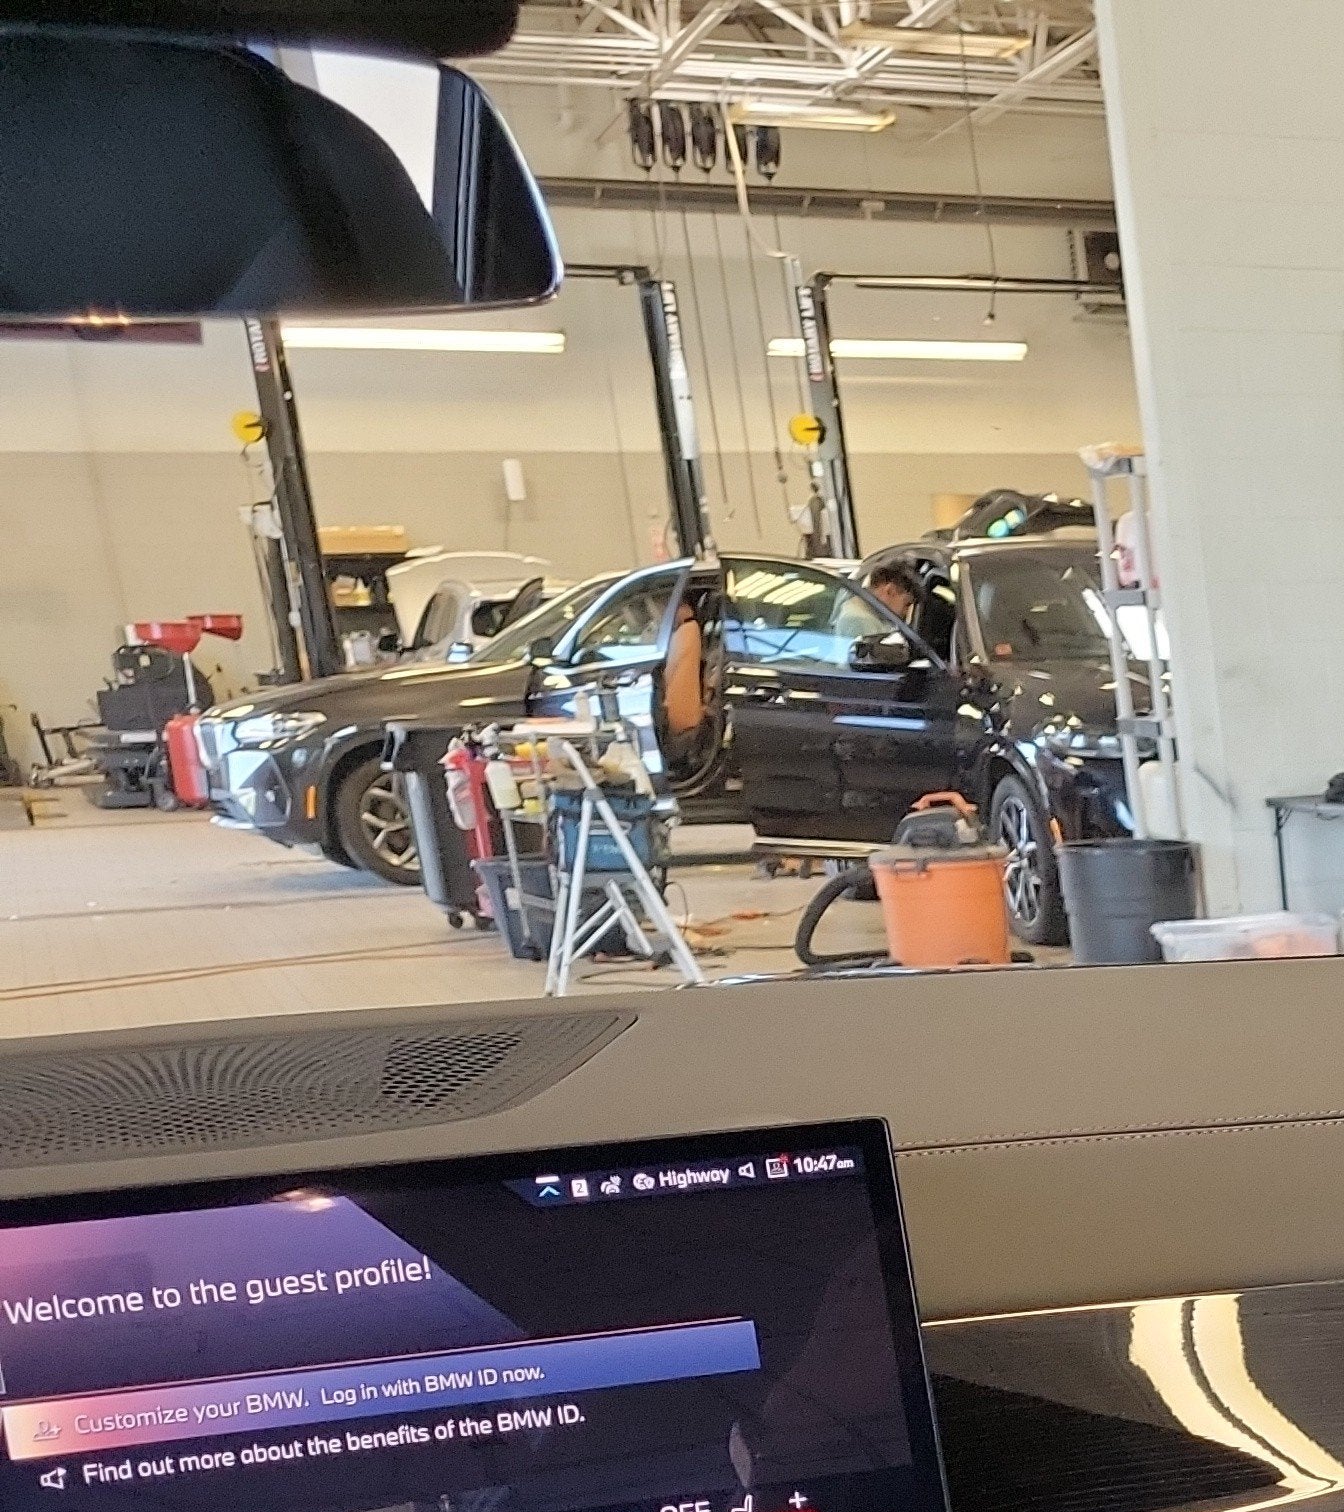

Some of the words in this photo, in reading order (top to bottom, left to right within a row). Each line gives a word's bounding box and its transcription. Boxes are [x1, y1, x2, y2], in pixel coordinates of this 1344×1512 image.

[659, 1166, 731, 1189] Highway
[4, 1287, 145, 1326] Welcome
[152, 1286, 182, 1311] to
[190, 1279, 238, 1306] the
[246, 1269, 328, 1304] guest
[335, 1255, 432, 1299] profile!
[74, 1404, 189, 1434] Customize
[193, 1399, 241, 1424] your
[245, 1387, 310, 1415] BMW.
[320, 1386, 357, 1407] Log
[360, 1383, 379, 1401] in
[381, 1378, 421, 1399] with
[424, 1370, 474, 1394] BMW
[478, 1368, 499, 1387] ID
[502, 1364, 546, 1385] now.
[83, 1458, 133, 1486] Find
[137, 1456, 176, 1478] out
[179, 1449, 236, 1473] more
[240, 1440, 305, 1466] about
[307, 1435, 343, 1457] the
[346, 1422, 431, 1452] benefits
[434, 1418, 456, 1441] of
[458, 1416, 493, 1438] the
[497, 1405, 553, 1433] BMW
[557, 1404, 586, 1425] ID.
